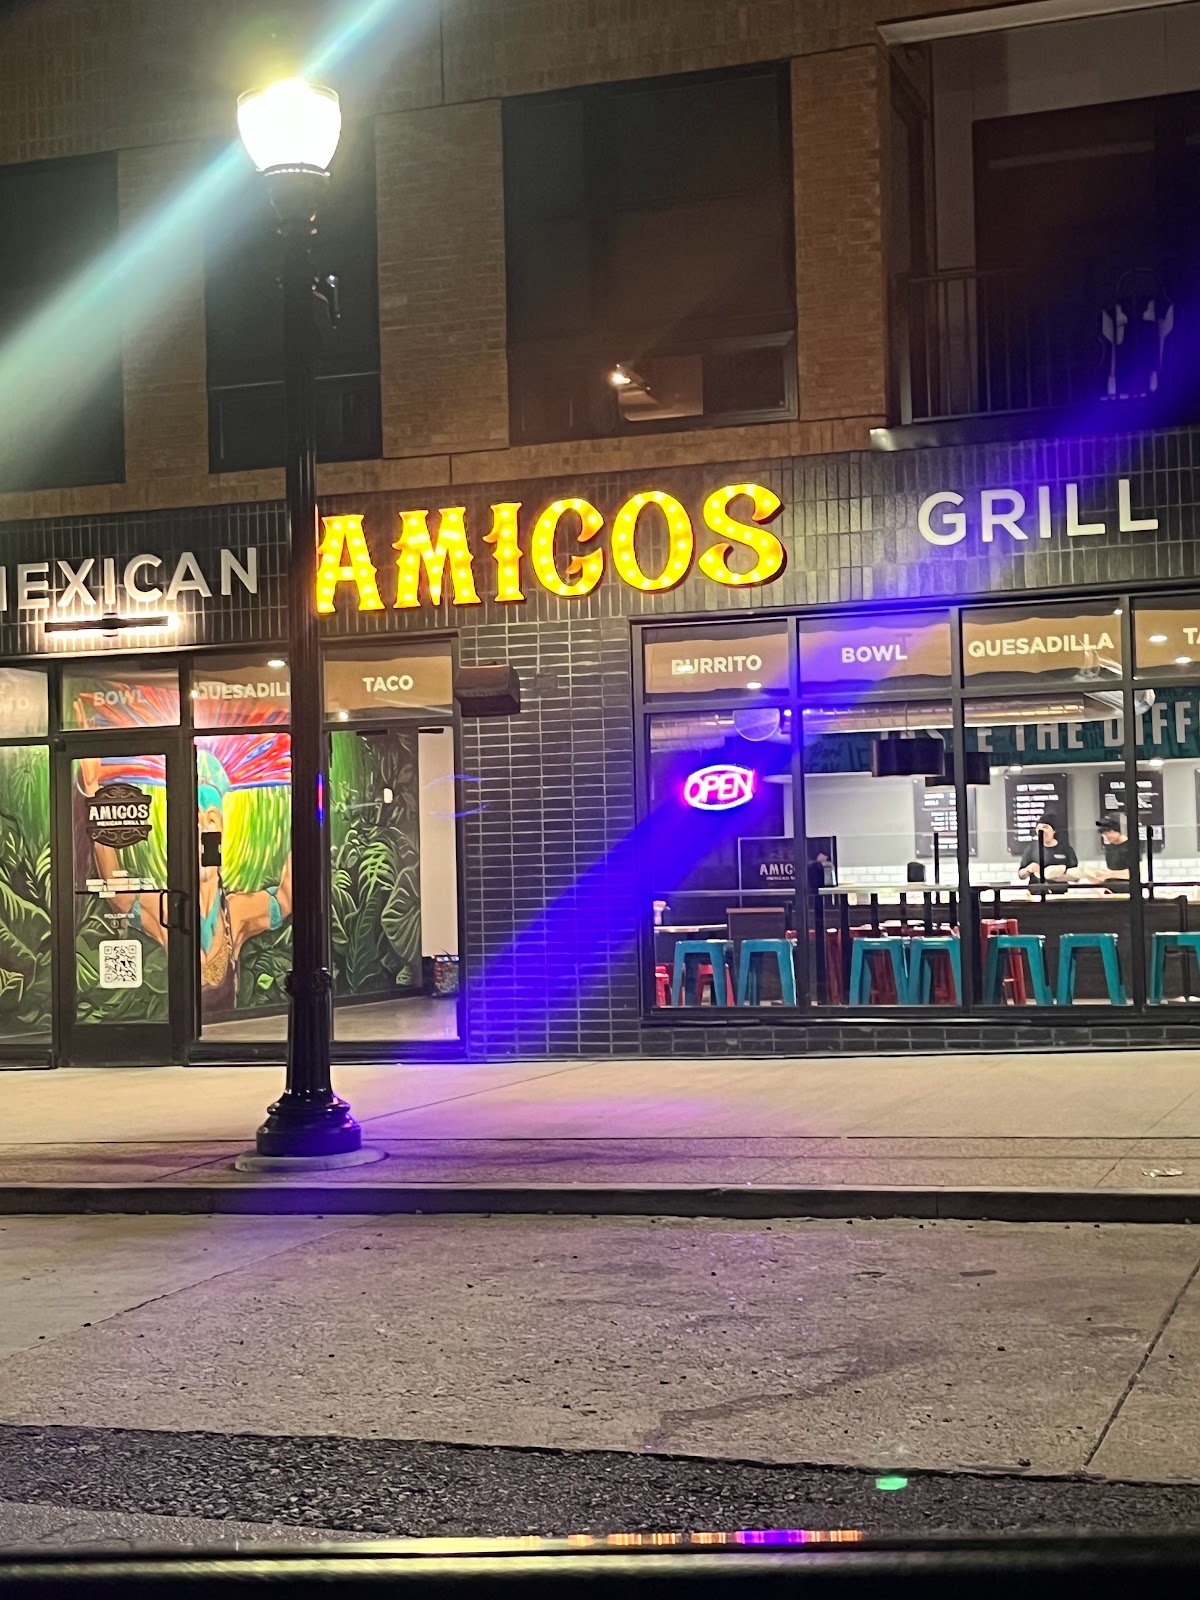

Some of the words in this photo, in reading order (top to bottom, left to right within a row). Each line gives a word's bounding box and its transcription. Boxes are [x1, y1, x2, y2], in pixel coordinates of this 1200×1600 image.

[0, 547, 258, 614] EXICAN
[316, 482, 788, 614] AMIGOS
[917, 478, 1159, 547] GRILL
[840, 643, 909, 664] BOWL
[967, 631, 1115, 659] QUESADILLA
[671, 654, 763, 676] BURRITO
[361, 674, 414, 692] TACO
[93, 690, 148, 706] BOWL
[684, 773, 754, 803] OPEN
[88, 804, 149, 820] AMIGOS
[759, 863, 796, 876] AMIG
